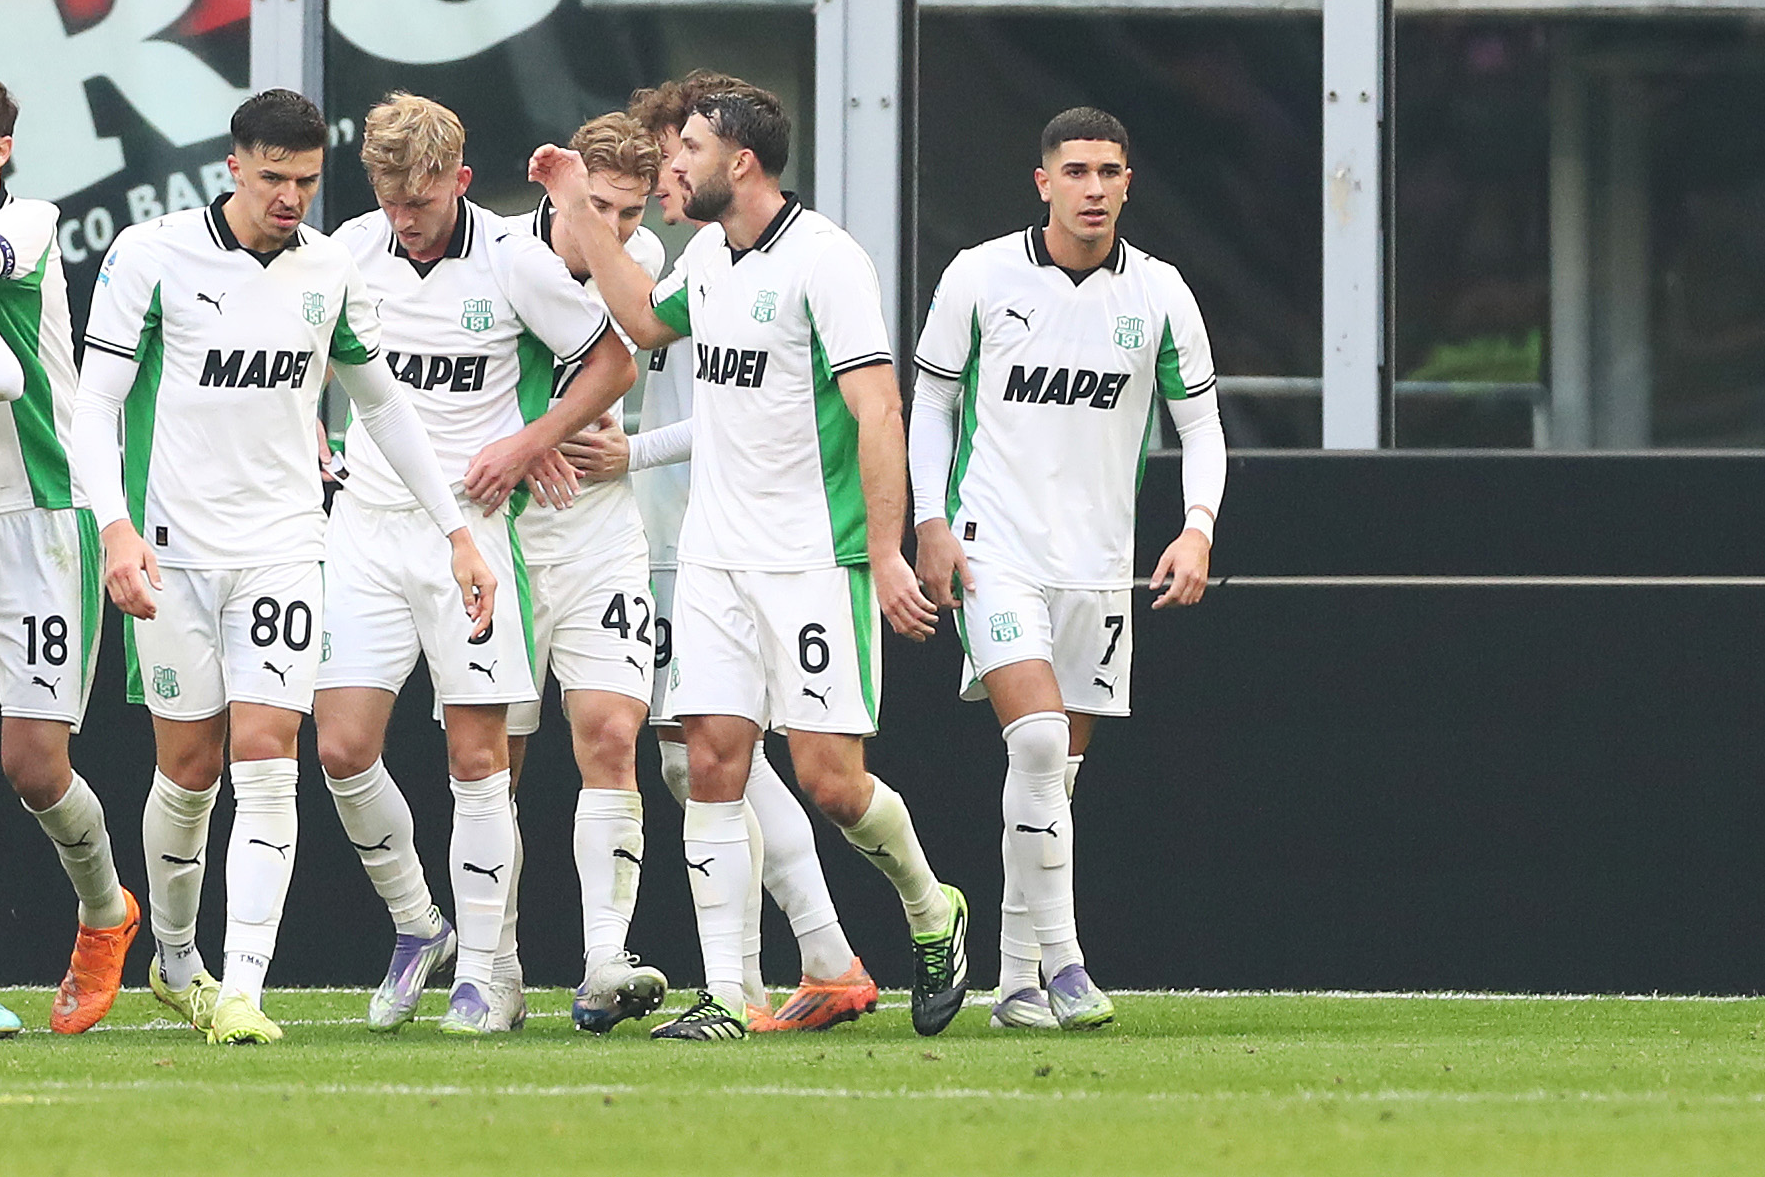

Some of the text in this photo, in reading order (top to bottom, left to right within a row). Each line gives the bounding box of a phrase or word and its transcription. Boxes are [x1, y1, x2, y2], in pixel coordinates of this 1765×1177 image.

[1002, 365, 1132, 410] MAPEI
[22, 614, 68, 666] 18
[250, 596, 312, 651] 80
[600, 593, 652, 647] 42
[1100, 615, 1124, 665] 7
[798, 623, 829, 674] 6
